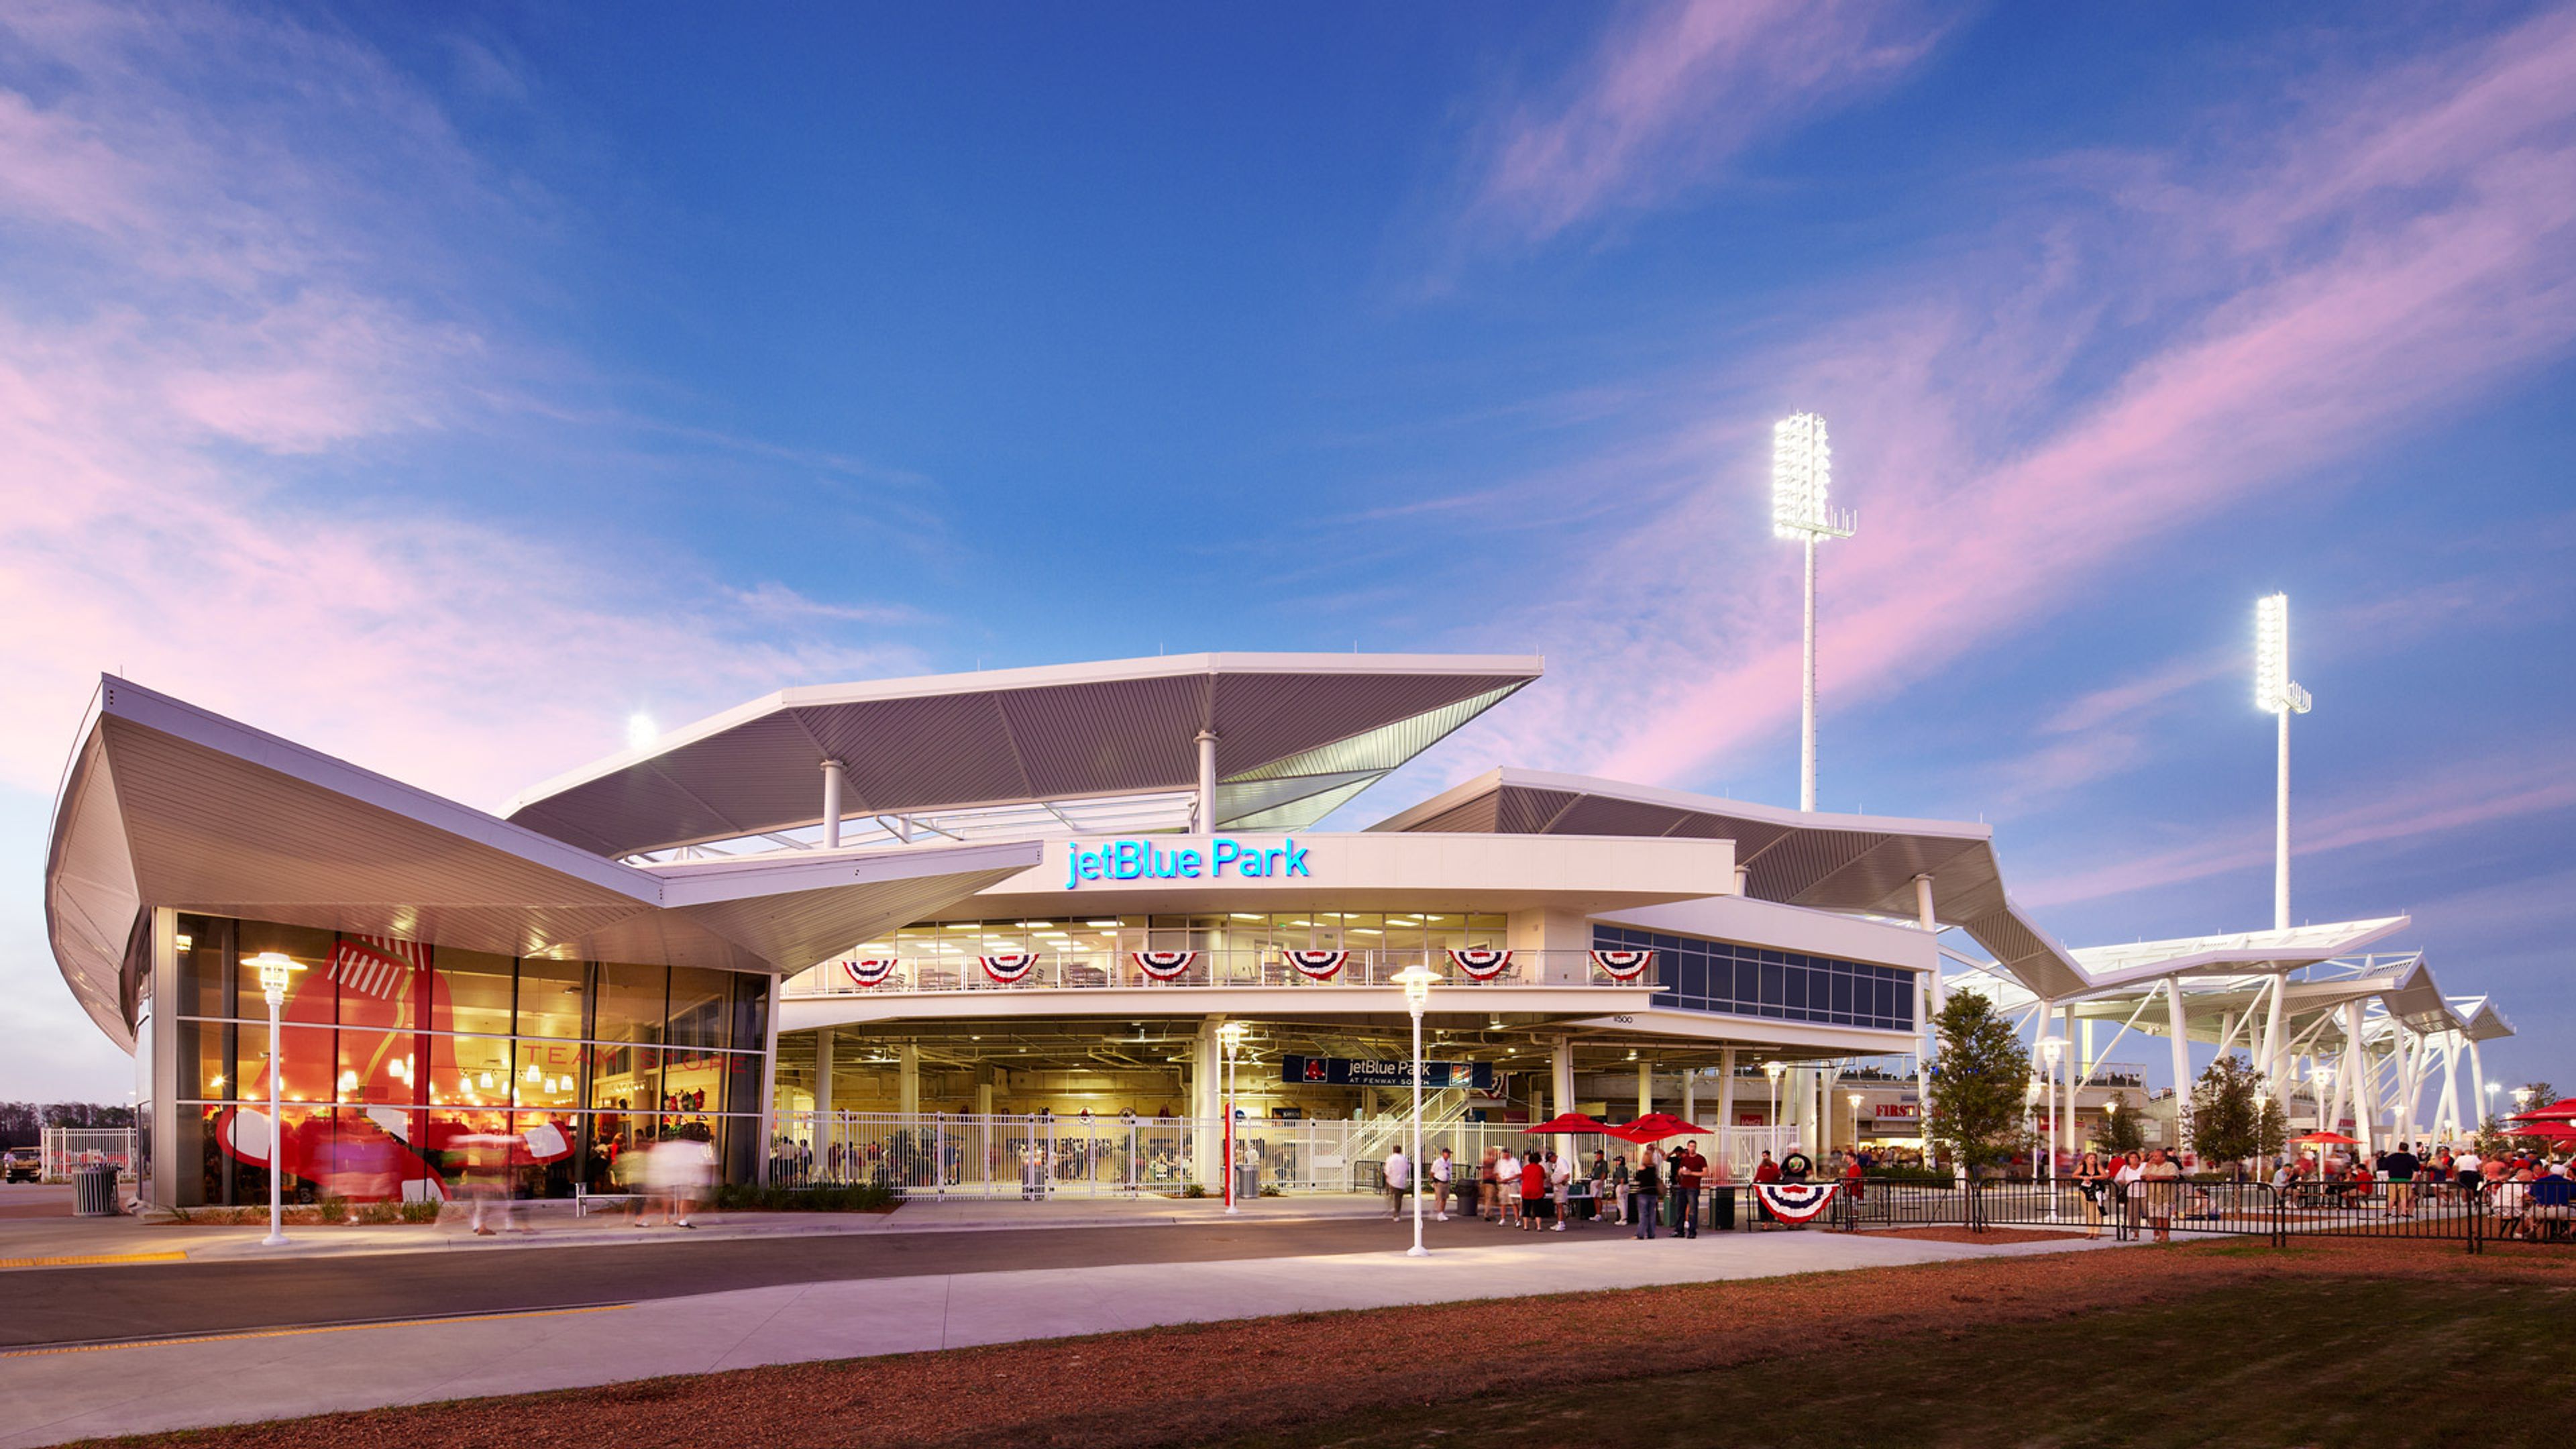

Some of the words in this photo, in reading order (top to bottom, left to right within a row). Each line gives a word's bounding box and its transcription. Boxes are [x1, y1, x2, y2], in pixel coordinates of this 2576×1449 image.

[1065, 840, 1201, 890] jetBlue
[1212, 837, 1309, 877] Park
[523, 1045, 616, 1067] TEAM
[639, 1051, 747, 1074] STORE
[1348, 1059, 1395, 1077] jetBlue
[1398, 1061, 1430, 1076] Pak
[1362, 1077, 1396, 1085] FENWAY
[1876, 1104, 1915, 1118] FIRST
